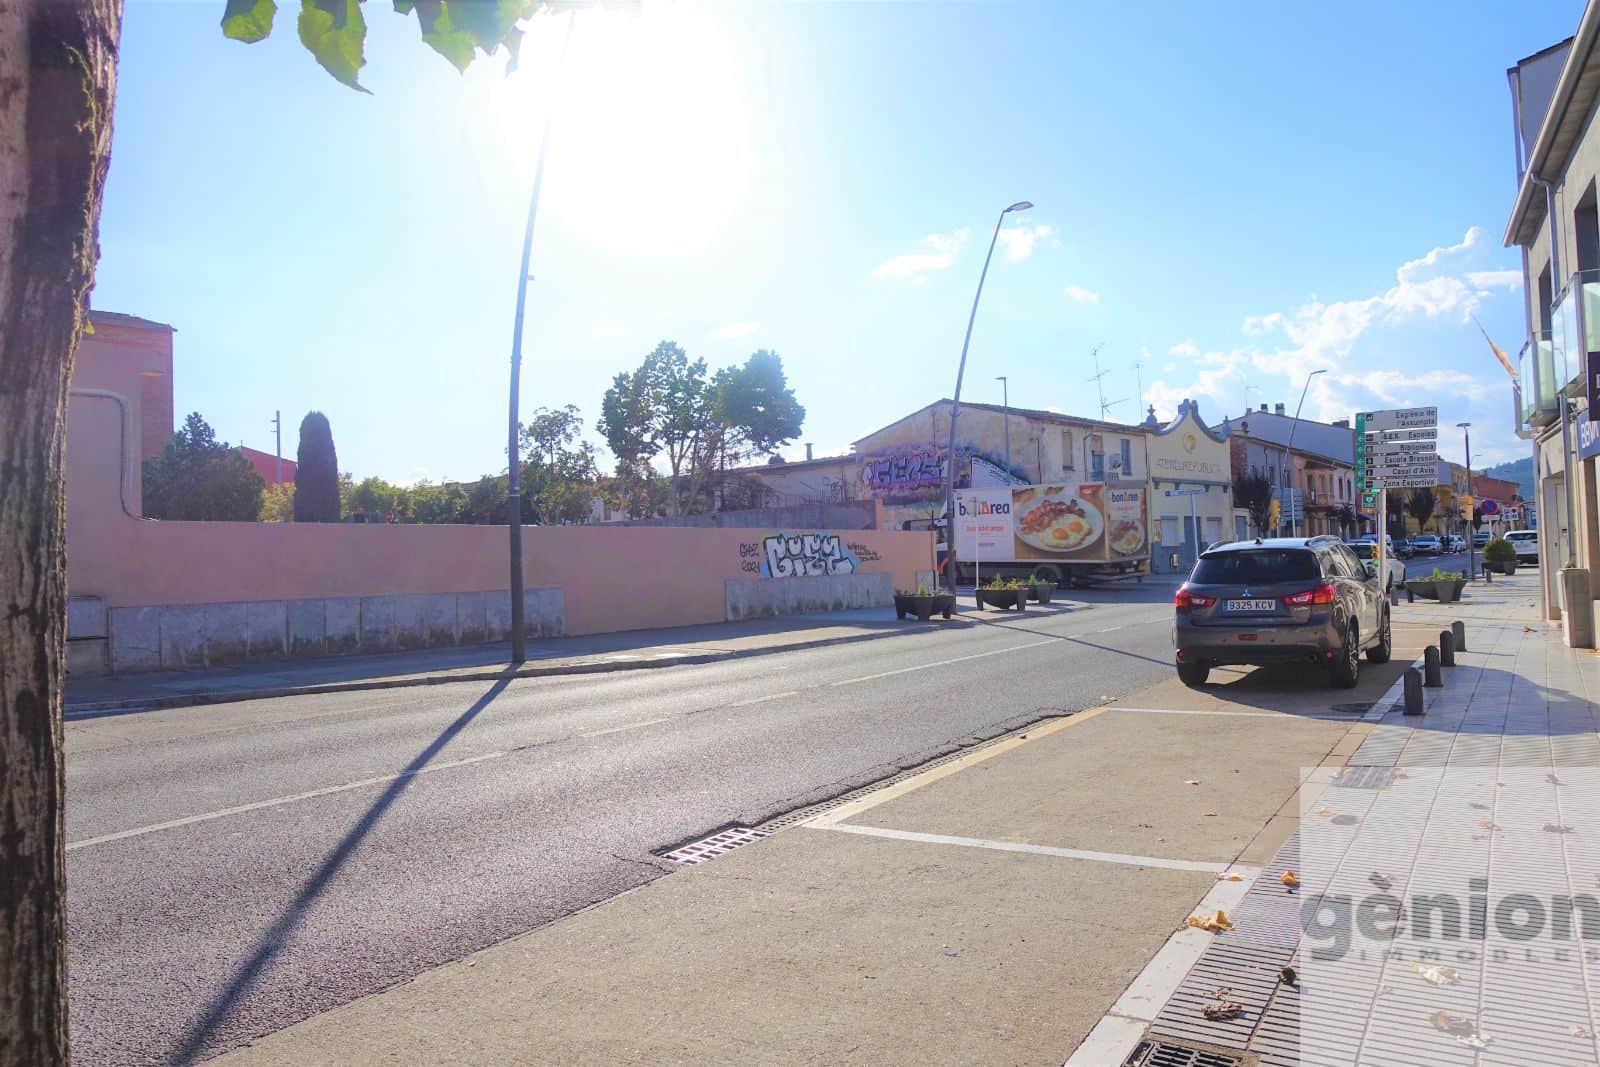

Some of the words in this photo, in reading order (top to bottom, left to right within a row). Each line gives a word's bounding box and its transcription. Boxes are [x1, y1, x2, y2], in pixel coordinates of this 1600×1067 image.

[1581, 421, 1599, 448] BBVA
[1403, 479, 1434, 488] Esportiva
[1229, 601, 1252, 610] 9325
[1255, 601, 1273, 610] KCV
